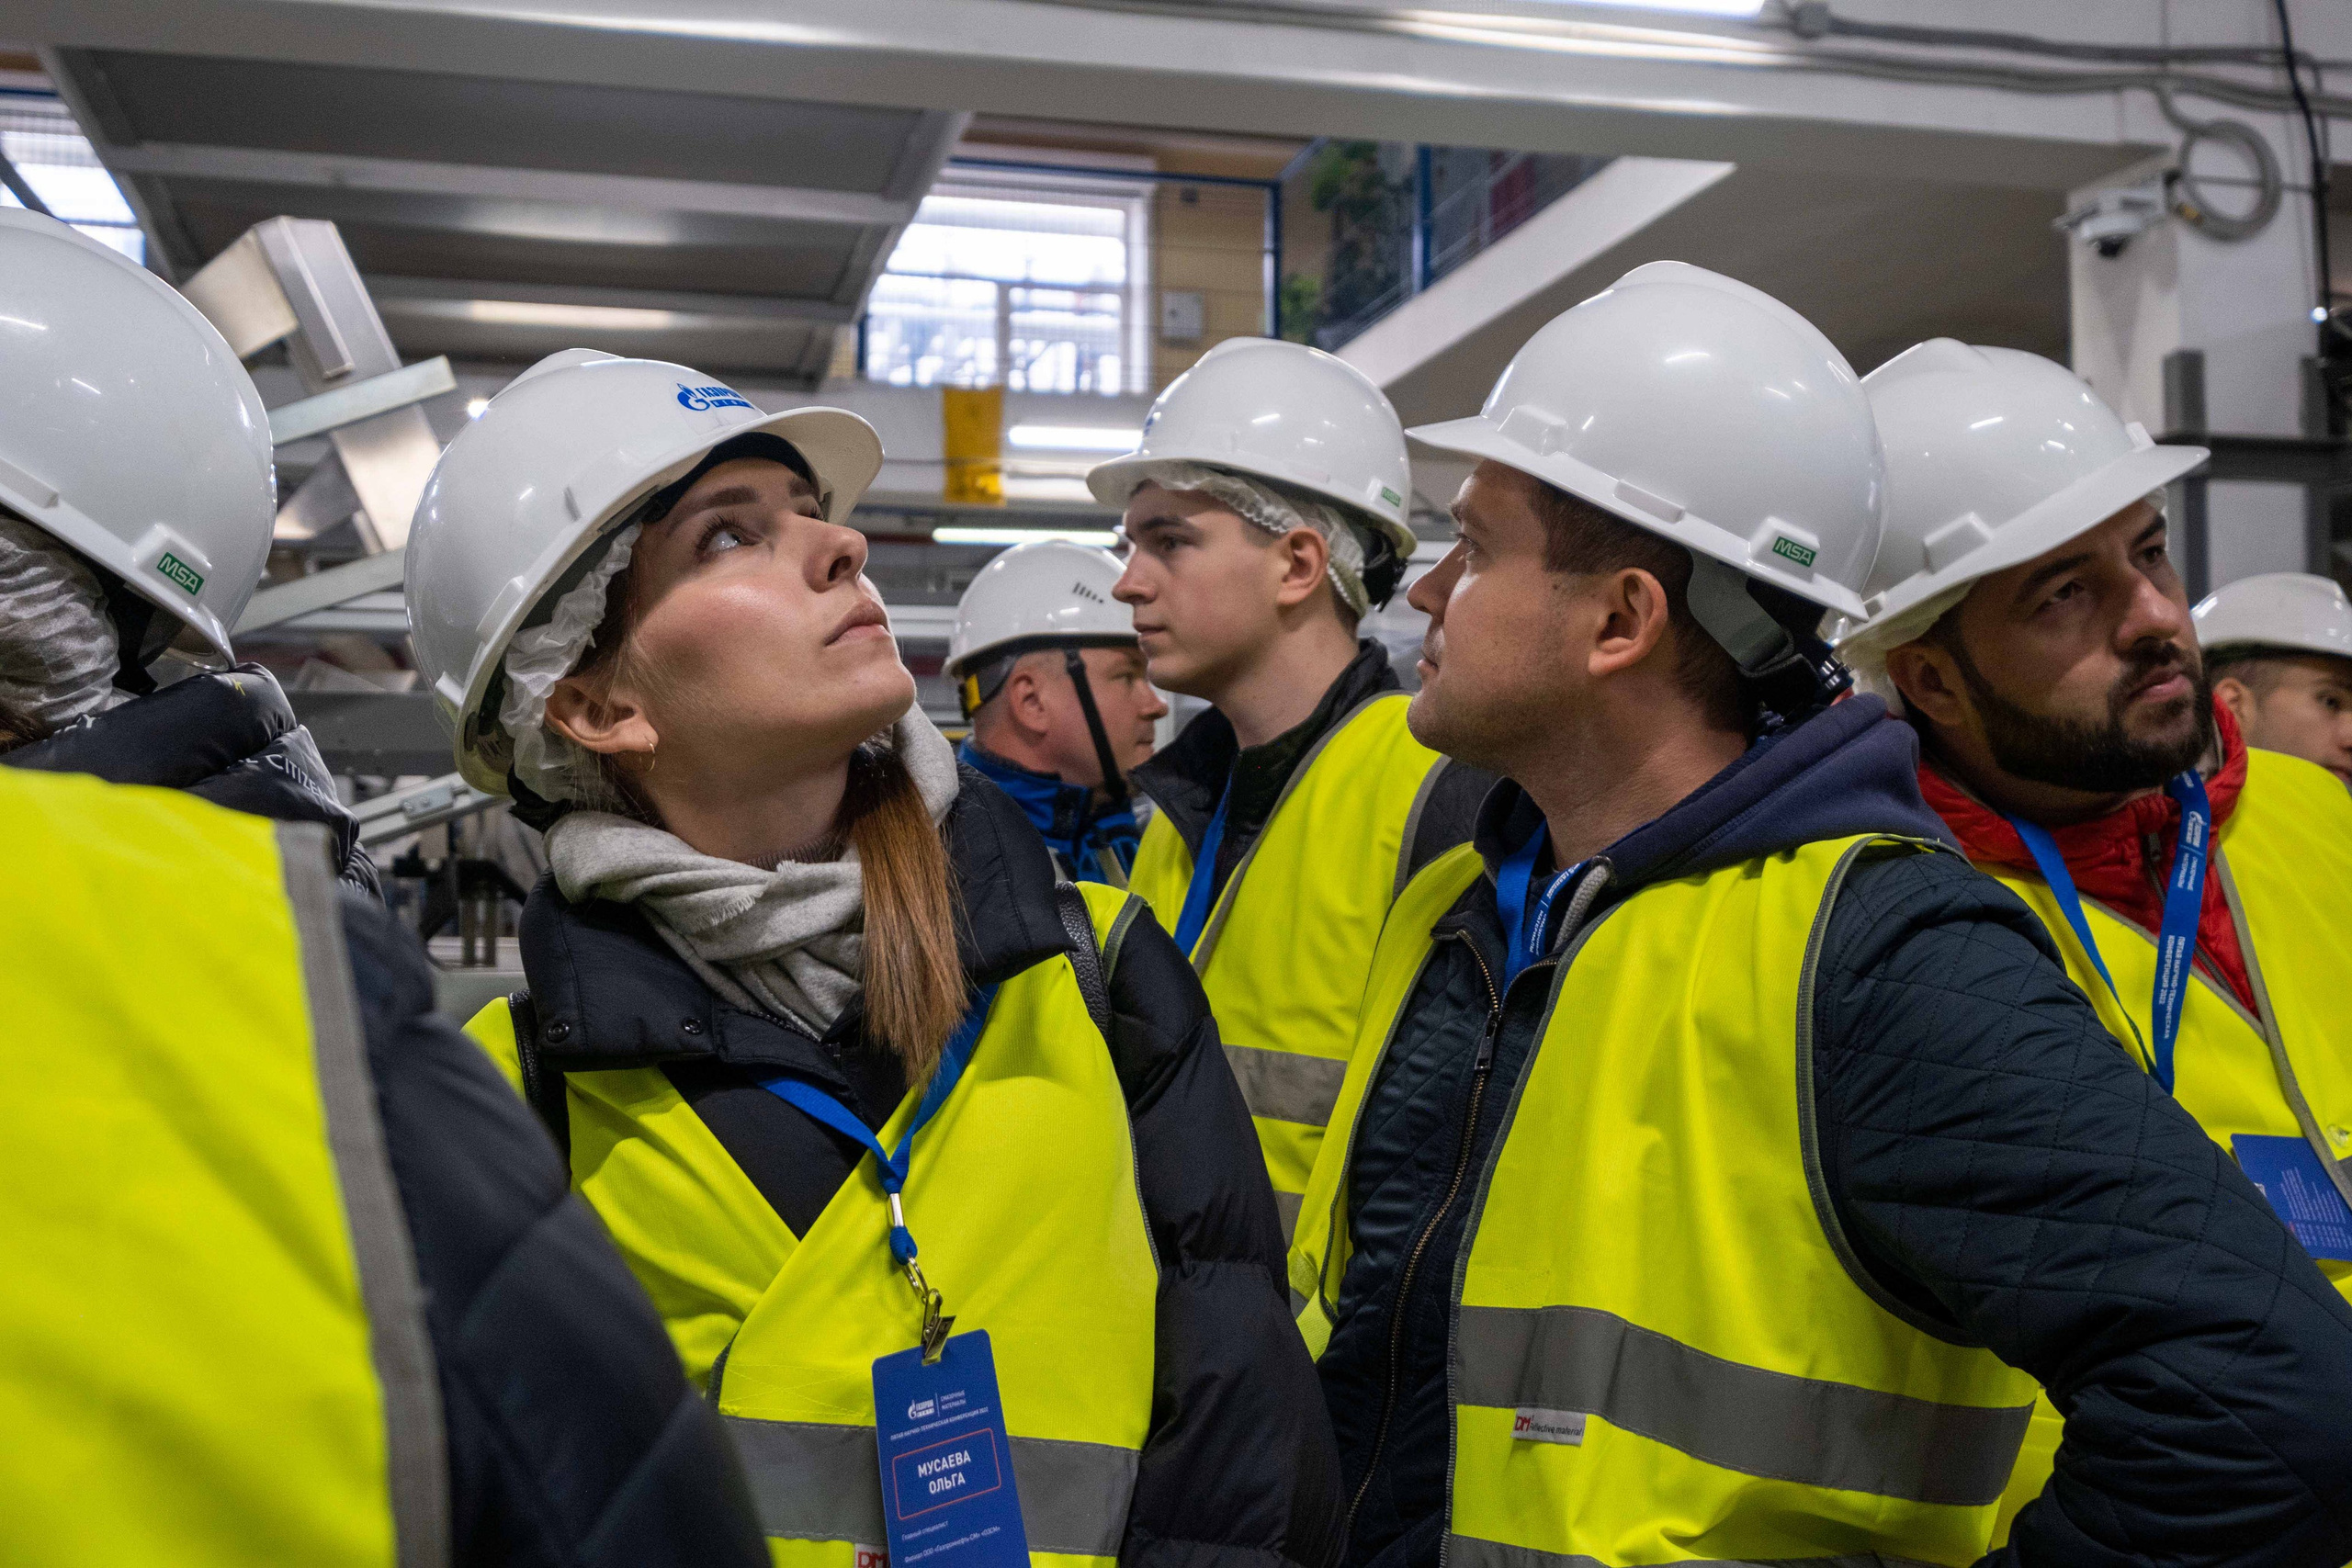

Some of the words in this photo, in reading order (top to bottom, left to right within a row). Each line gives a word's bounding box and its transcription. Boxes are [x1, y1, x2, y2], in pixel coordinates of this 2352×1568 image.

[1774, 538, 1813, 565] MSA
[159, 555, 199, 592] MSA
[2162, 935, 2176, 988] КОНФЕРЕНЦИЯ
[1514, 1416, 1532, 1432] DM
[1555, 1427, 1582, 1436] material
[917, 1450, 971, 1478] МУСАЕВА
[929, 1472, 966, 1495] ОЛЬГА
